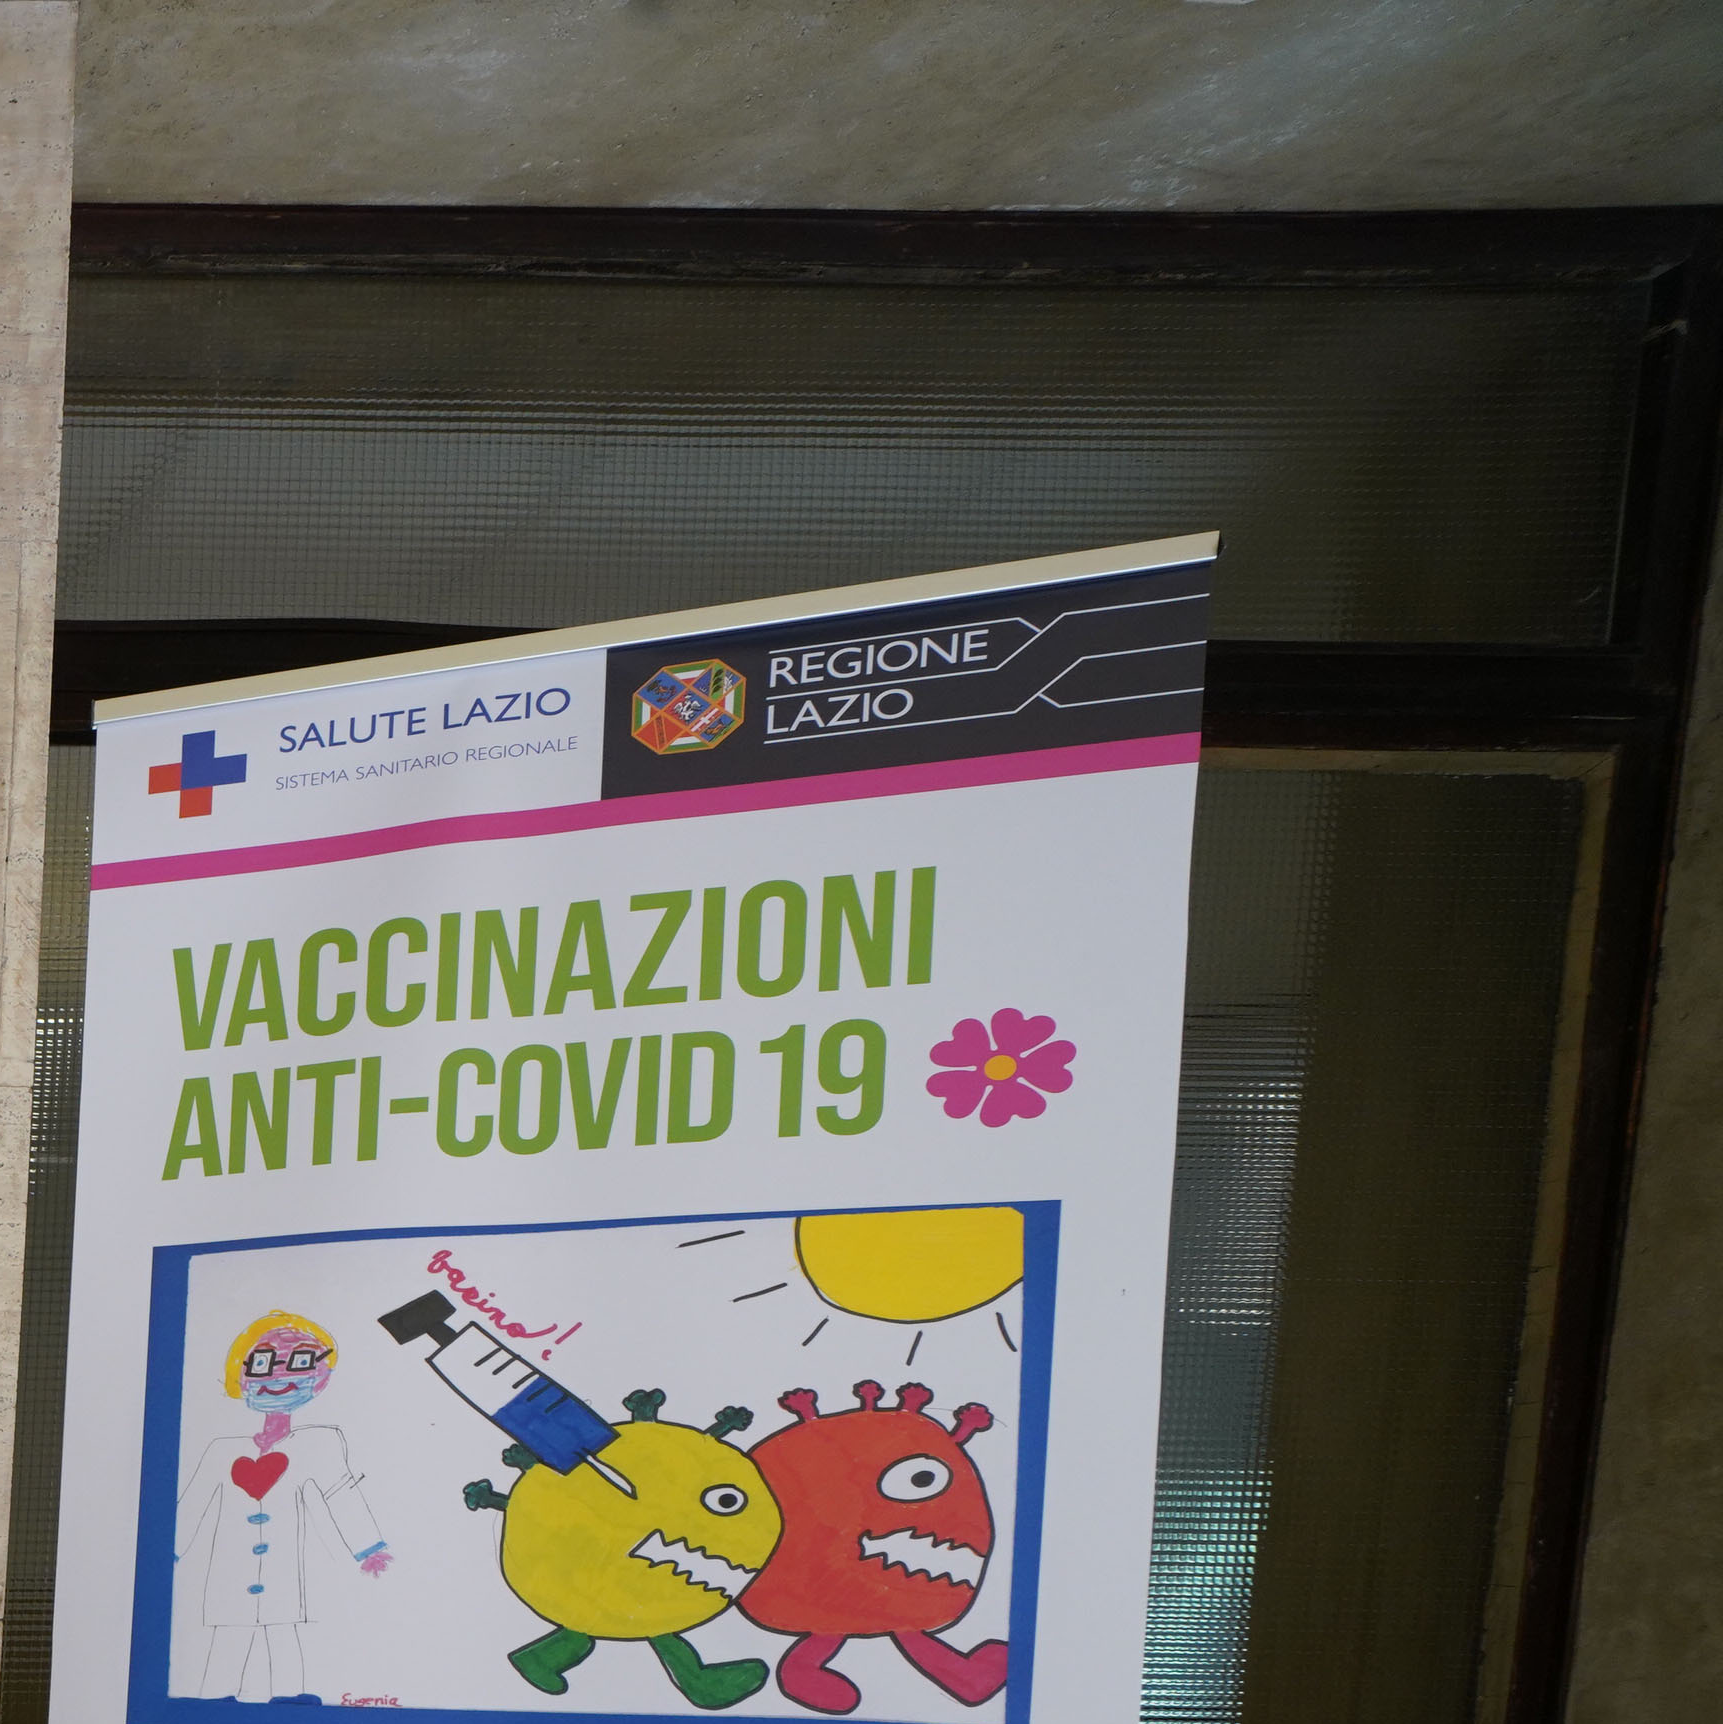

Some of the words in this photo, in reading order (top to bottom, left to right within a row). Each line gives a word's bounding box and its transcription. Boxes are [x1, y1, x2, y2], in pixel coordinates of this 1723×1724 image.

[768, 628, 990, 687] REGIONE
[277, 705, 427, 754] SALUTE
[442, 687, 572, 732] LAZIO
[766, 688, 914, 735] LAZIO
[275, 766, 349, 792] SISTEMA
[354, 749, 459, 783] SANITARIO
[464, 735, 579, 769] REGIONALE
[170, 866, 938, 1052] VACCINAZIONI
[161, 1030, 737, 1181] ANTI-COVID
[759, 1018, 888, 1141] 19
[340, 1692, 404, 1708] Eugenia
